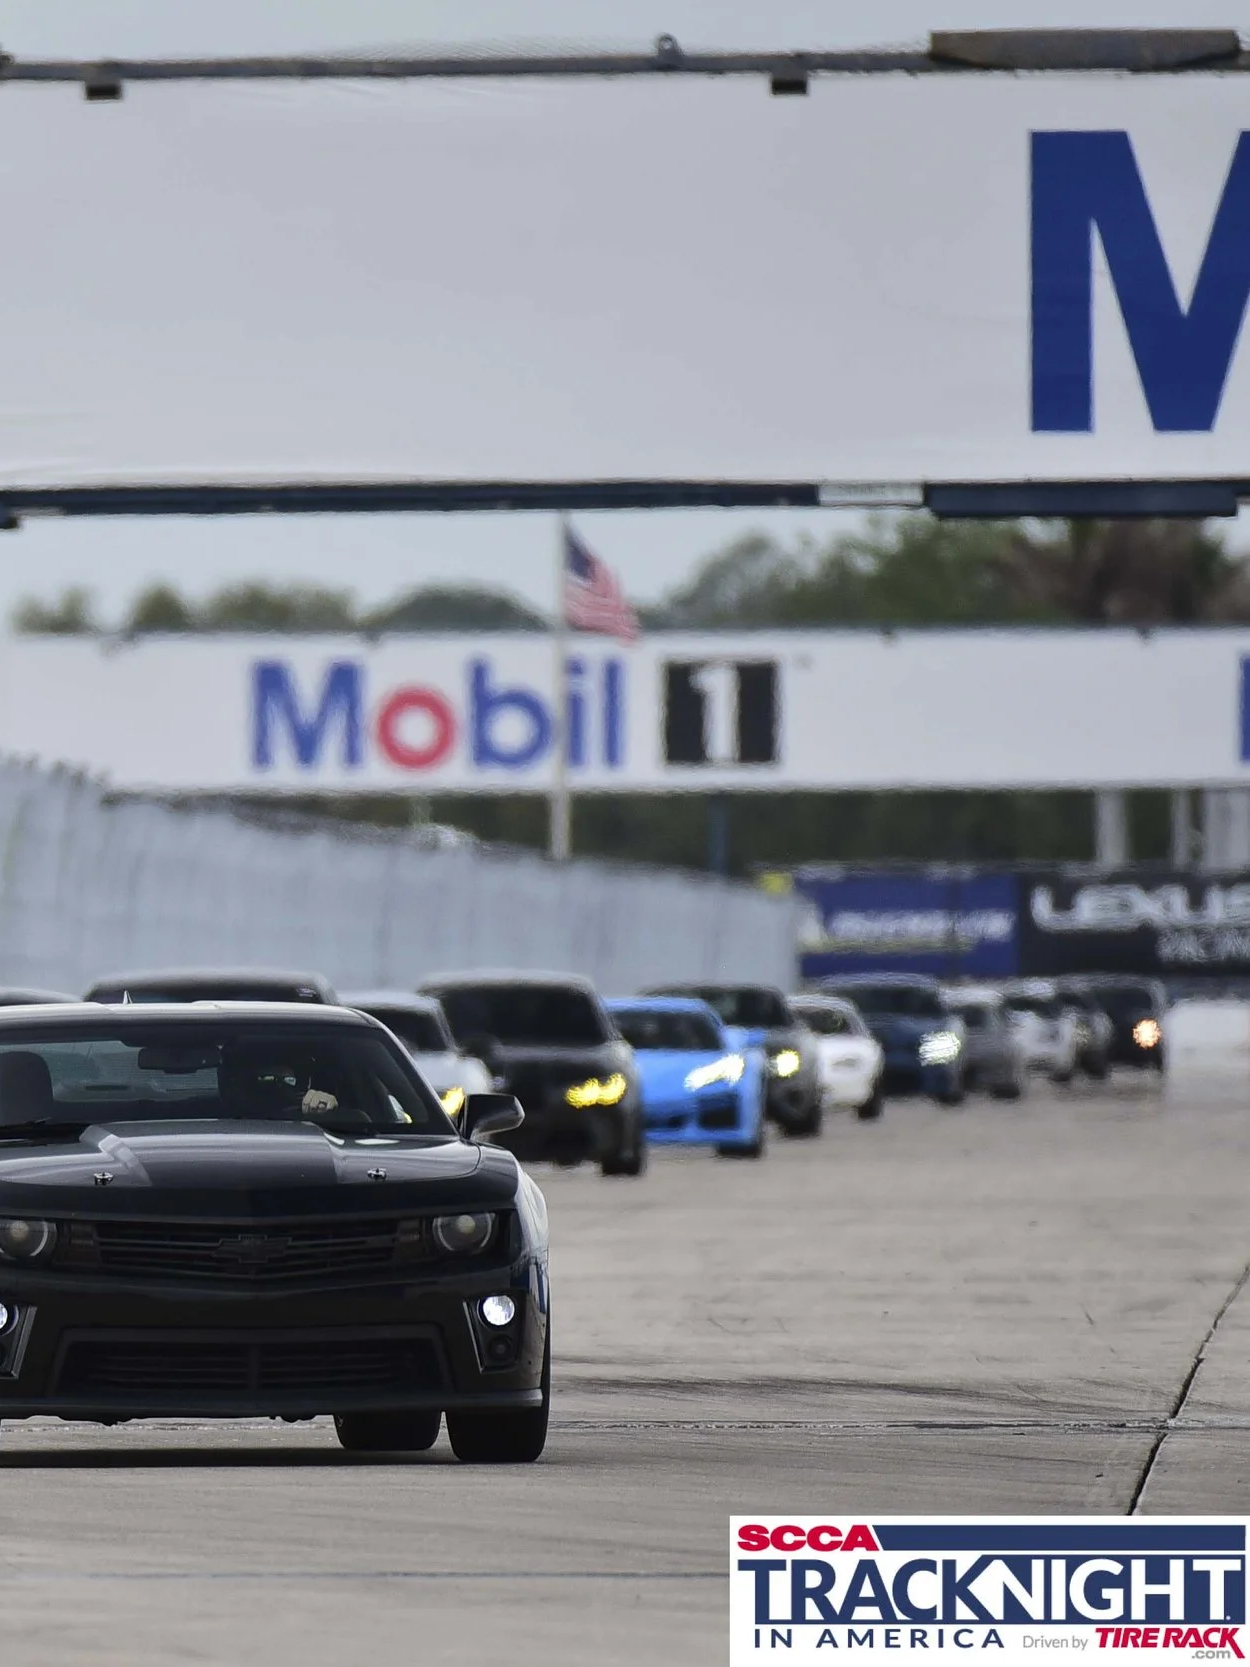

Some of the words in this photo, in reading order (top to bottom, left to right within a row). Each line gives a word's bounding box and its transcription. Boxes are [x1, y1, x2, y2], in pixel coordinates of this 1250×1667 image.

[1030, 130, 1250, 432] M
[251, 656, 623, 771] Mobil
[686, 662, 741, 764] 1
